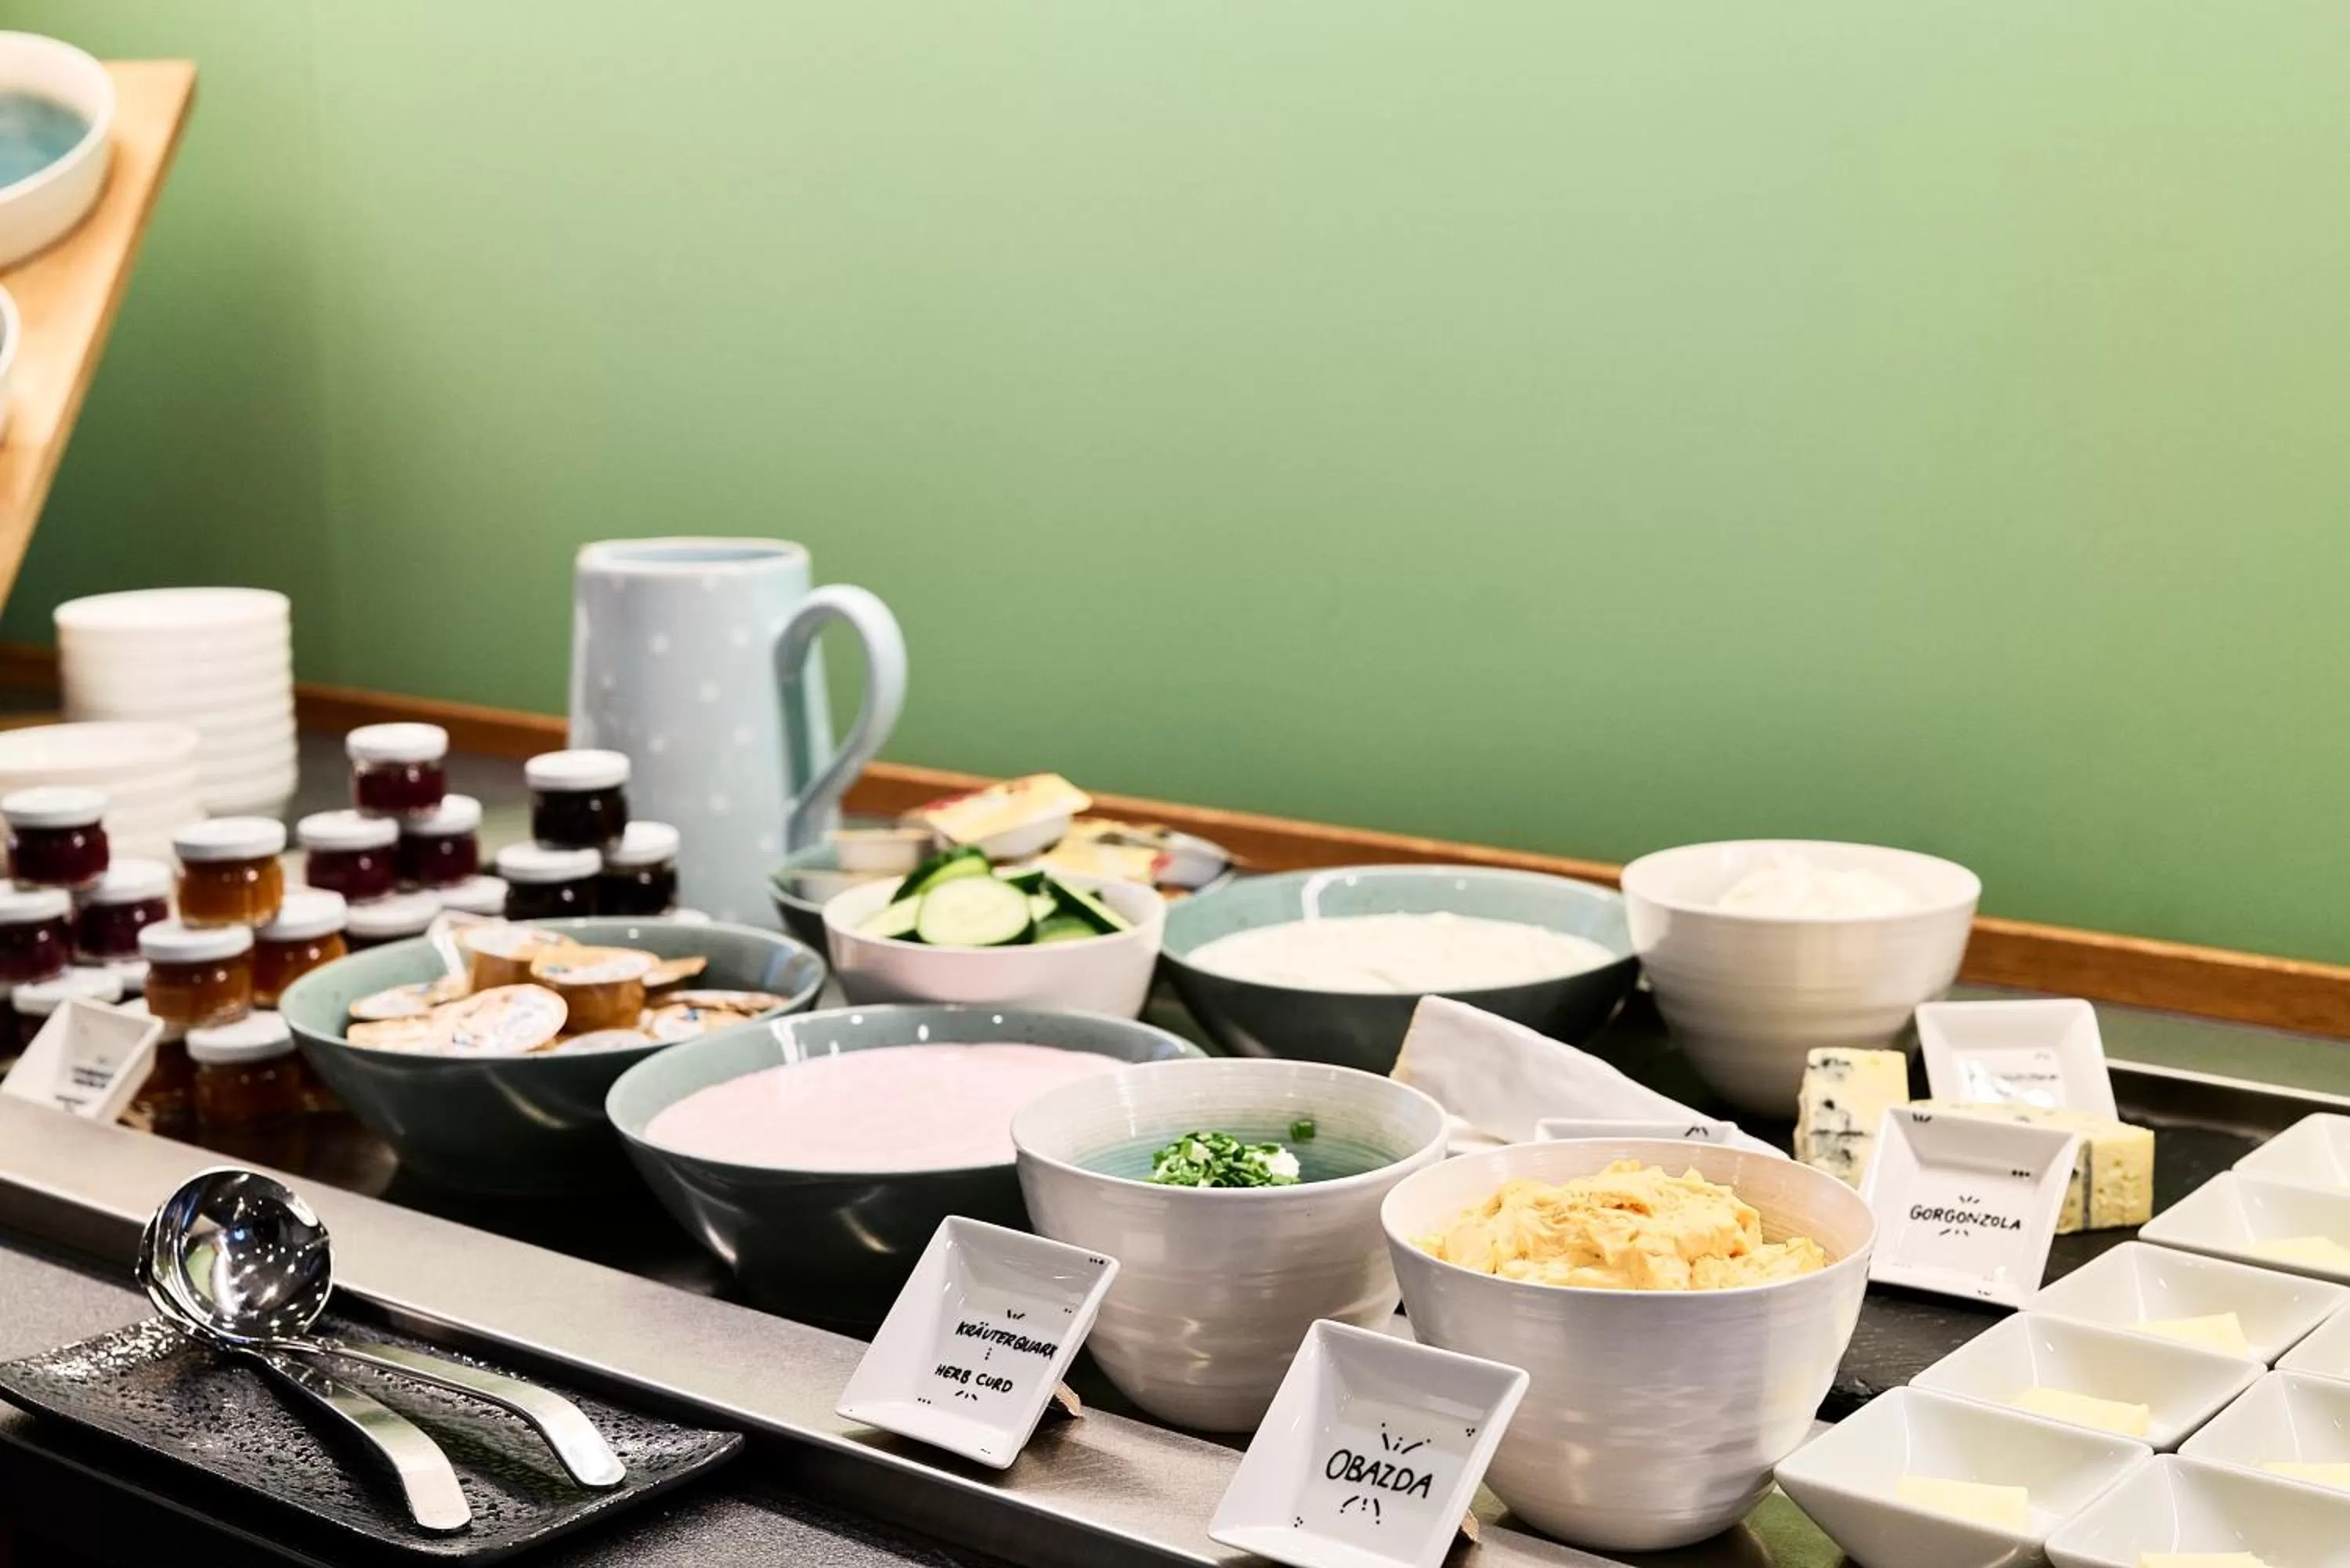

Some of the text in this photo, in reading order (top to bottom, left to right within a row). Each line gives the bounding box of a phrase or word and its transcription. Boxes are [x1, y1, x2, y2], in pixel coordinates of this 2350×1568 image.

[1910, 1205, 2021, 1230] GORGONZOLA
[935, 1364, 1013, 1393] HERB CURD
[1326, 1449, 1433, 1499] OBAZDA
